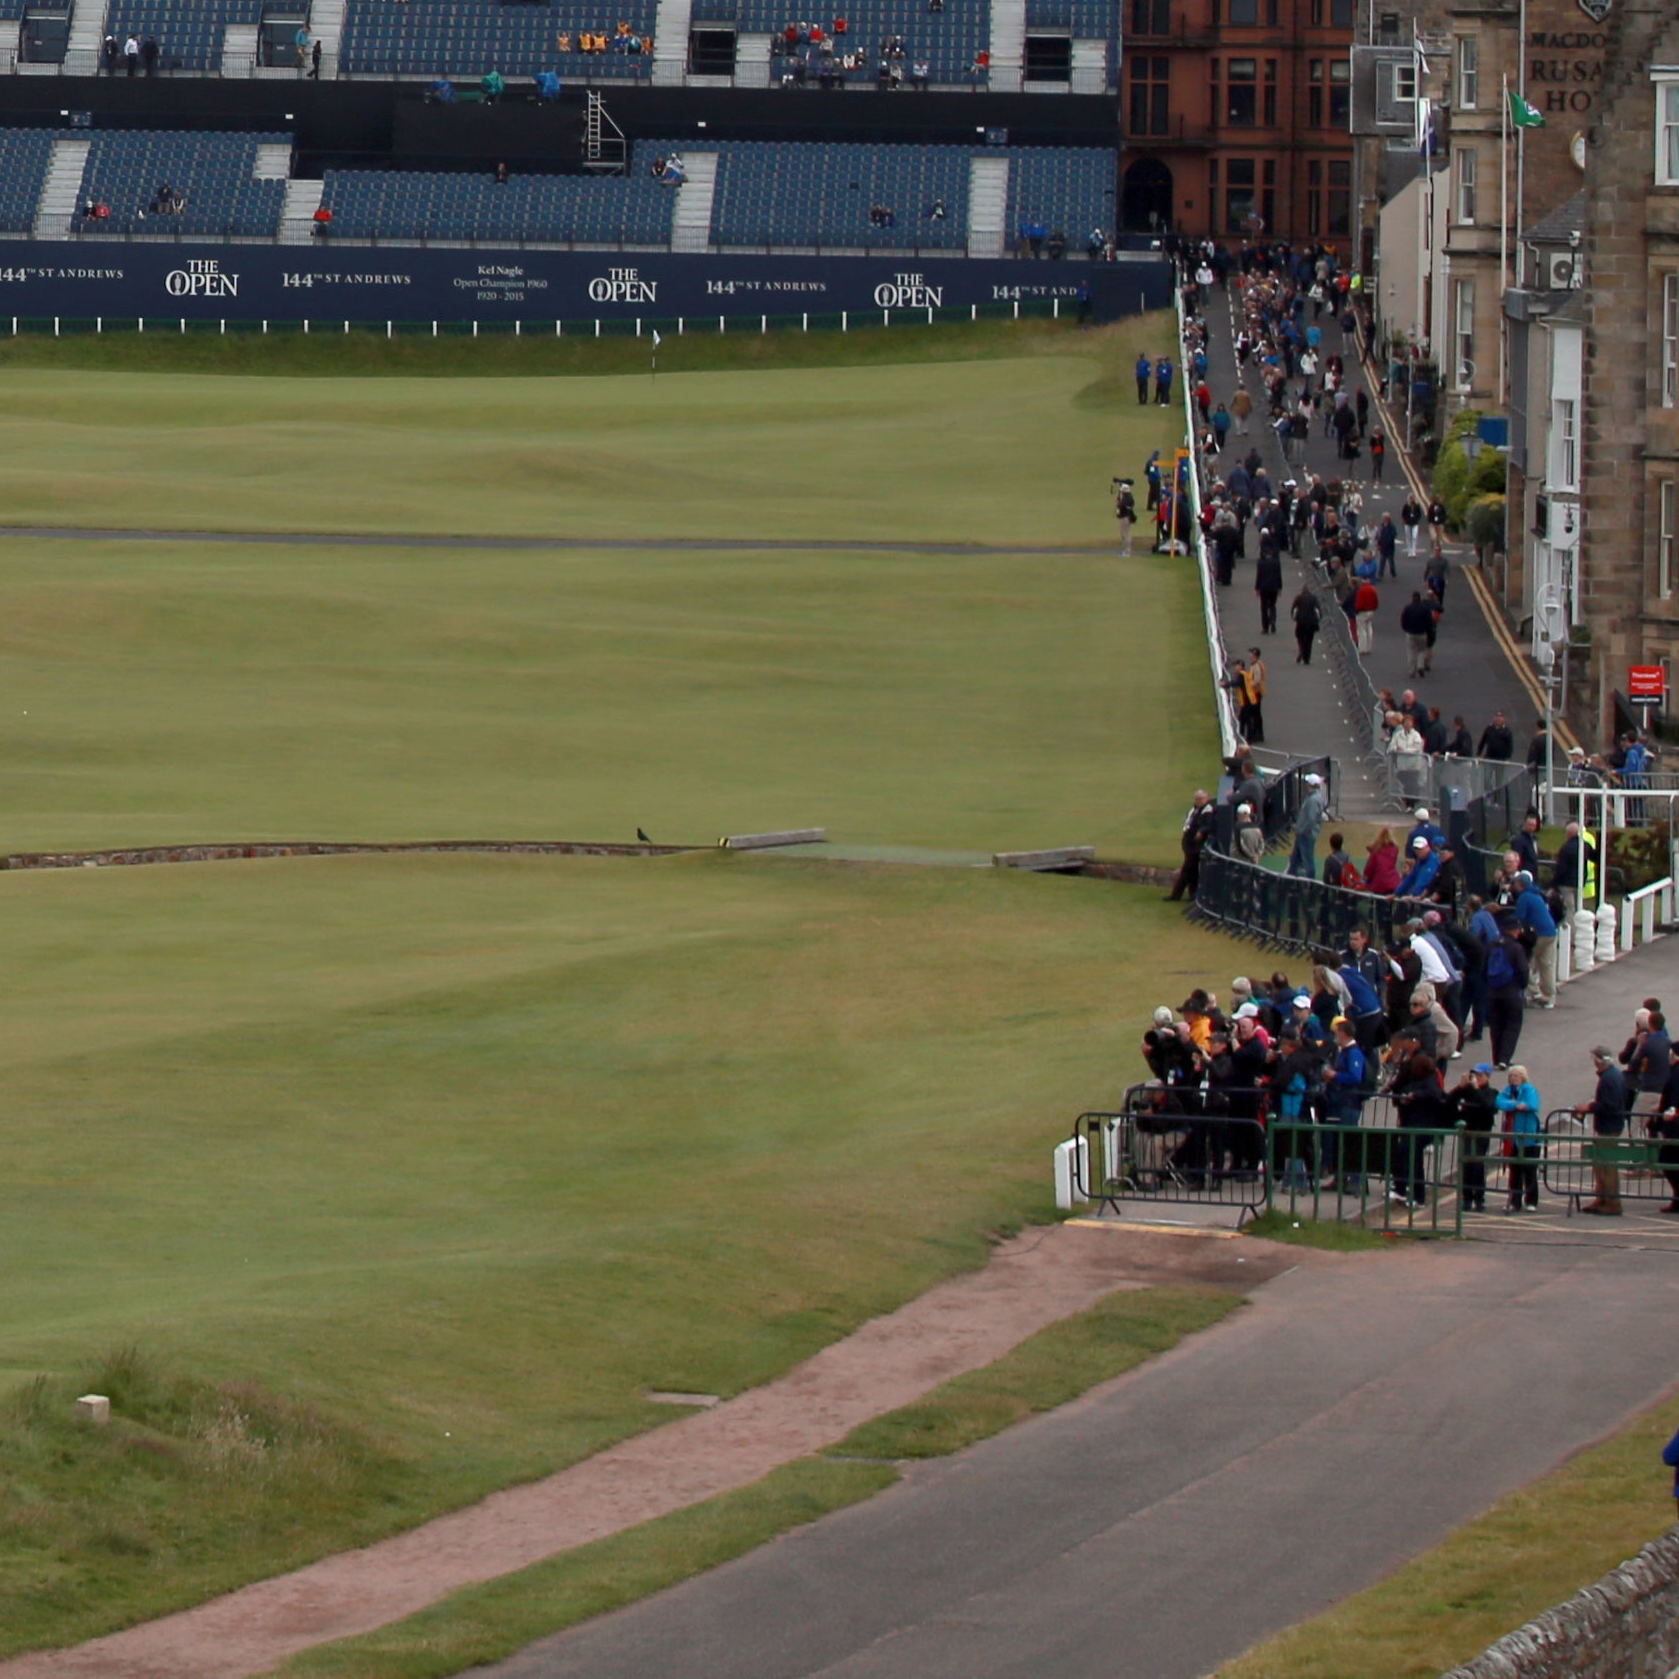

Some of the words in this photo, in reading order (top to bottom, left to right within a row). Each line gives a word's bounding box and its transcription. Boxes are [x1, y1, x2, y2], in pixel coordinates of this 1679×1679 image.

[1530, 60, 1604, 82] RUSA
[187, 260, 219, 273] THE
[478, 266, 495, 275] Kel
[497, 266, 524, 278] Nagle
[38, 268, 54, 278] ST
[57, 269, 124, 279] ANDREWS
[325, 274, 341, 283] ST
[344, 274, 411, 284] ANDREWS
[608, 268, 638, 281] THE
[894, 273, 924, 286] THE
[165, 270, 239, 297] OPEN
[453, 278, 478, 289] Open
[479, 279, 525, 290] Champion
[746, 282, 761, 290] ST
[764, 282, 827, 292] ANDREWS
[504, 291, 524, 301] 2015
[588, 278, 657, 303] OPEN
[874, 283, 943, 308] OPEN
[1031, 286, 1048, 296] ST
